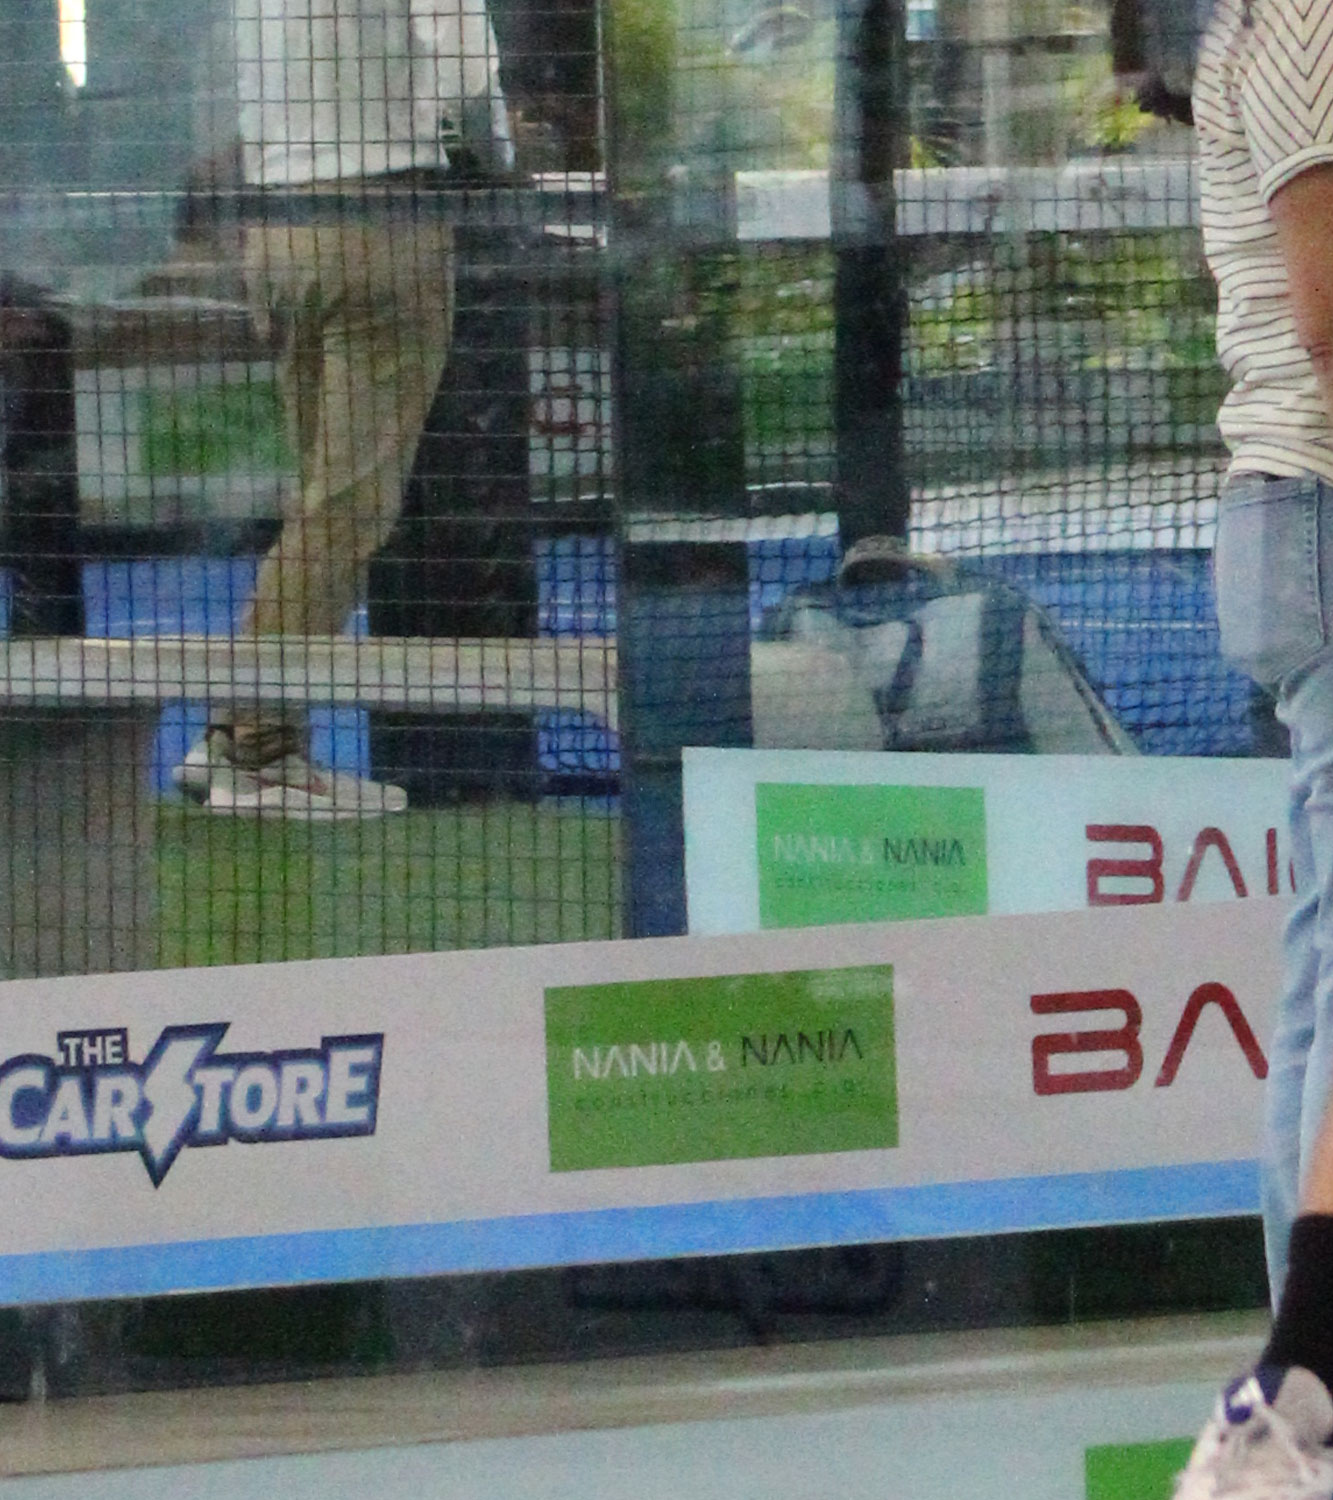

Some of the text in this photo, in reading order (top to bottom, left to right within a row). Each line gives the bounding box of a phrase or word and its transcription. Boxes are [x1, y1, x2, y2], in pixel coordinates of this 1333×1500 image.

[883, 837, 966, 866] NANIA
[1085, 824, 1296, 906] BAI
[61, 1033, 127, 1065] THE
[573, 1028, 864, 1081] NANIA & NANIA
[1030, 981, 1268, 1096] BA
